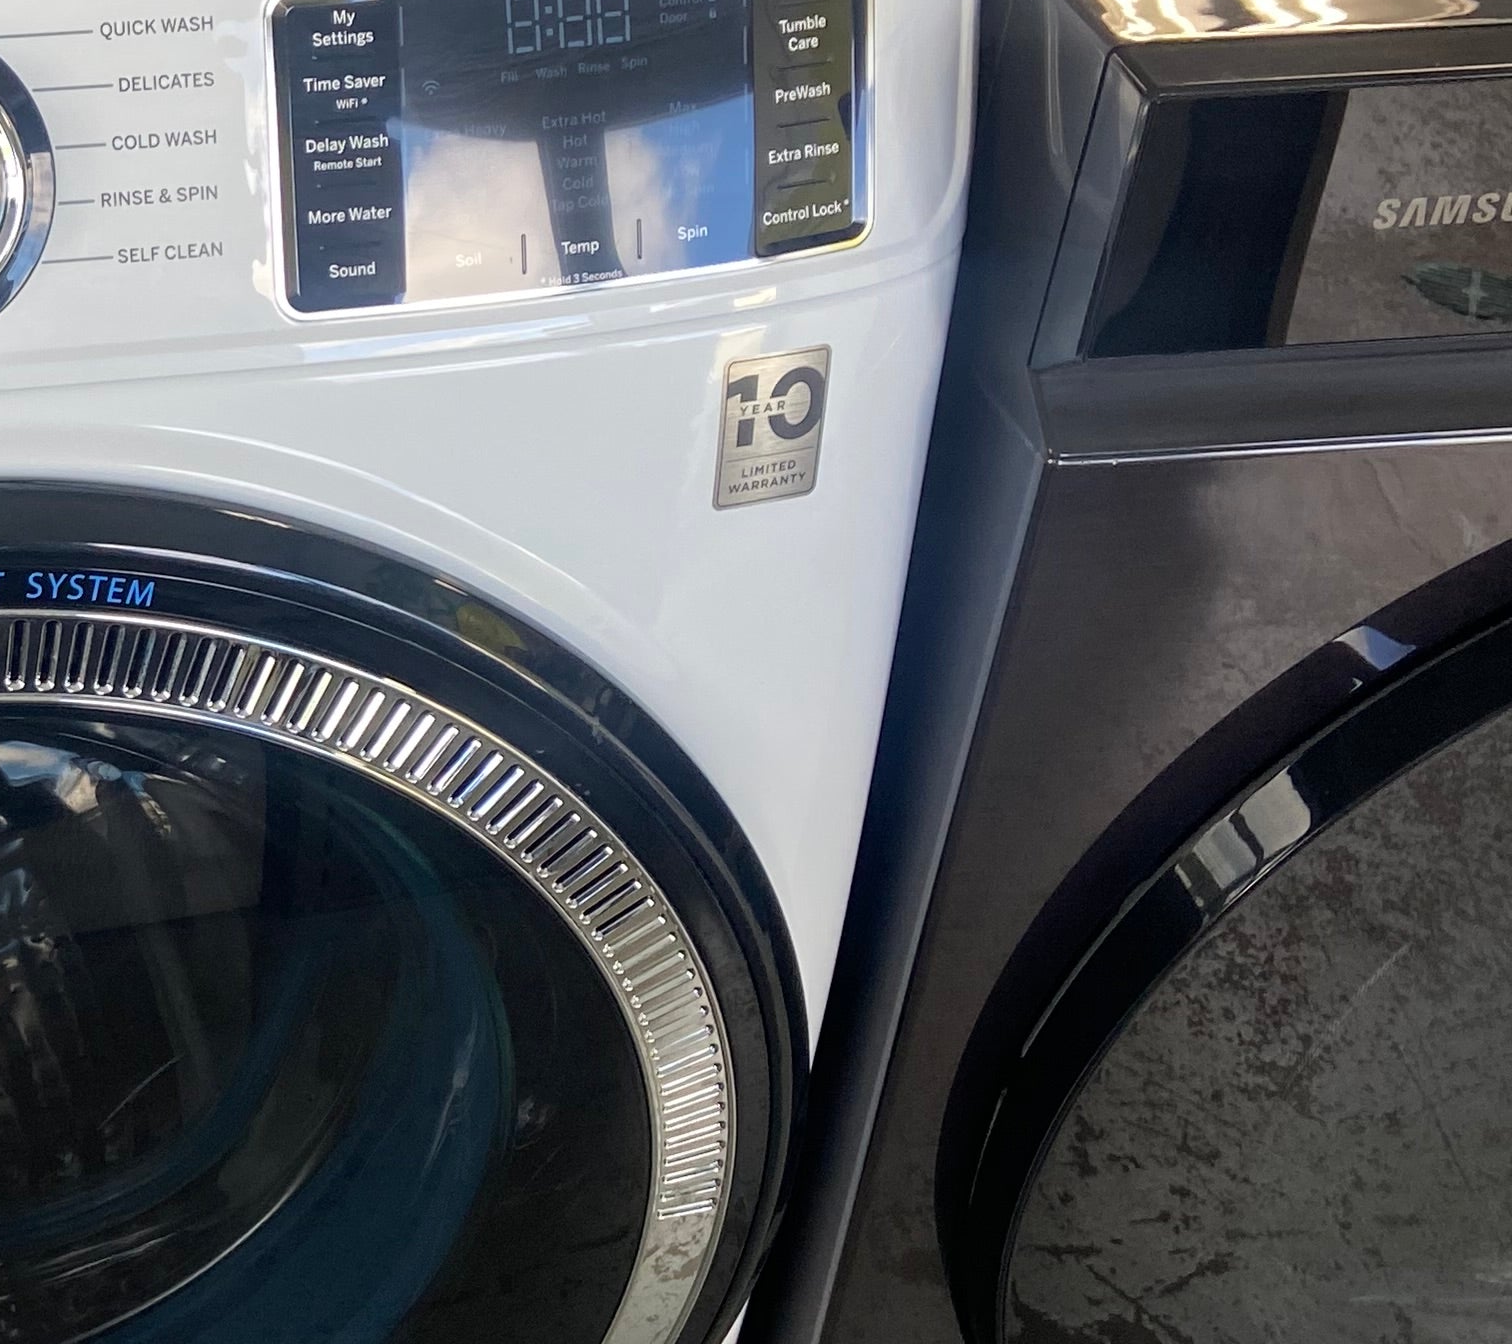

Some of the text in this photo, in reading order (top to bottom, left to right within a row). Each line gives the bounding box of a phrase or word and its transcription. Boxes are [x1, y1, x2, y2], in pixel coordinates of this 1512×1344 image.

[100, 15, 214, 41] QUICK WASH
[332, 9, 356, 27] My
[778, 14, 827, 34] Tumble
[312, 30, 375, 48] Settings
[788, 35, 820, 53] Care
[118, 72, 215, 93] DELICATES
[303, 74, 386, 92] Time Saver
[774, 81, 831, 104] PreWash
[111, 129, 217, 151] COLD WASH
[305, 133, 389, 154] Delay Wash
[313, 156, 383, 171] Remote Start
[768, 141, 840, 166] Extra Rinse
[100, 185, 219, 208] RINSE & SPIN
[308, 205, 392, 225] More Water
[763, 206, 810, 226] Control
[677, 224, 708, 242] Spin
[117, 242, 223, 264] SELF CLEAN
[561, 239, 600, 256] Temp
[328, 261, 377, 279] Sound
[455, 252, 483, 268] Soil
[548, 274, 571, 287] Hold
[582, 268, 624, 283] Seconds
[726, 366, 826, 448] 10
[740, 400, 786, 417] YEAR
[741, 459, 796, 478] LIMITED
[728, 471, 807, 494] WARRANTY
[25, 571, 155, 608] SYSTEM
